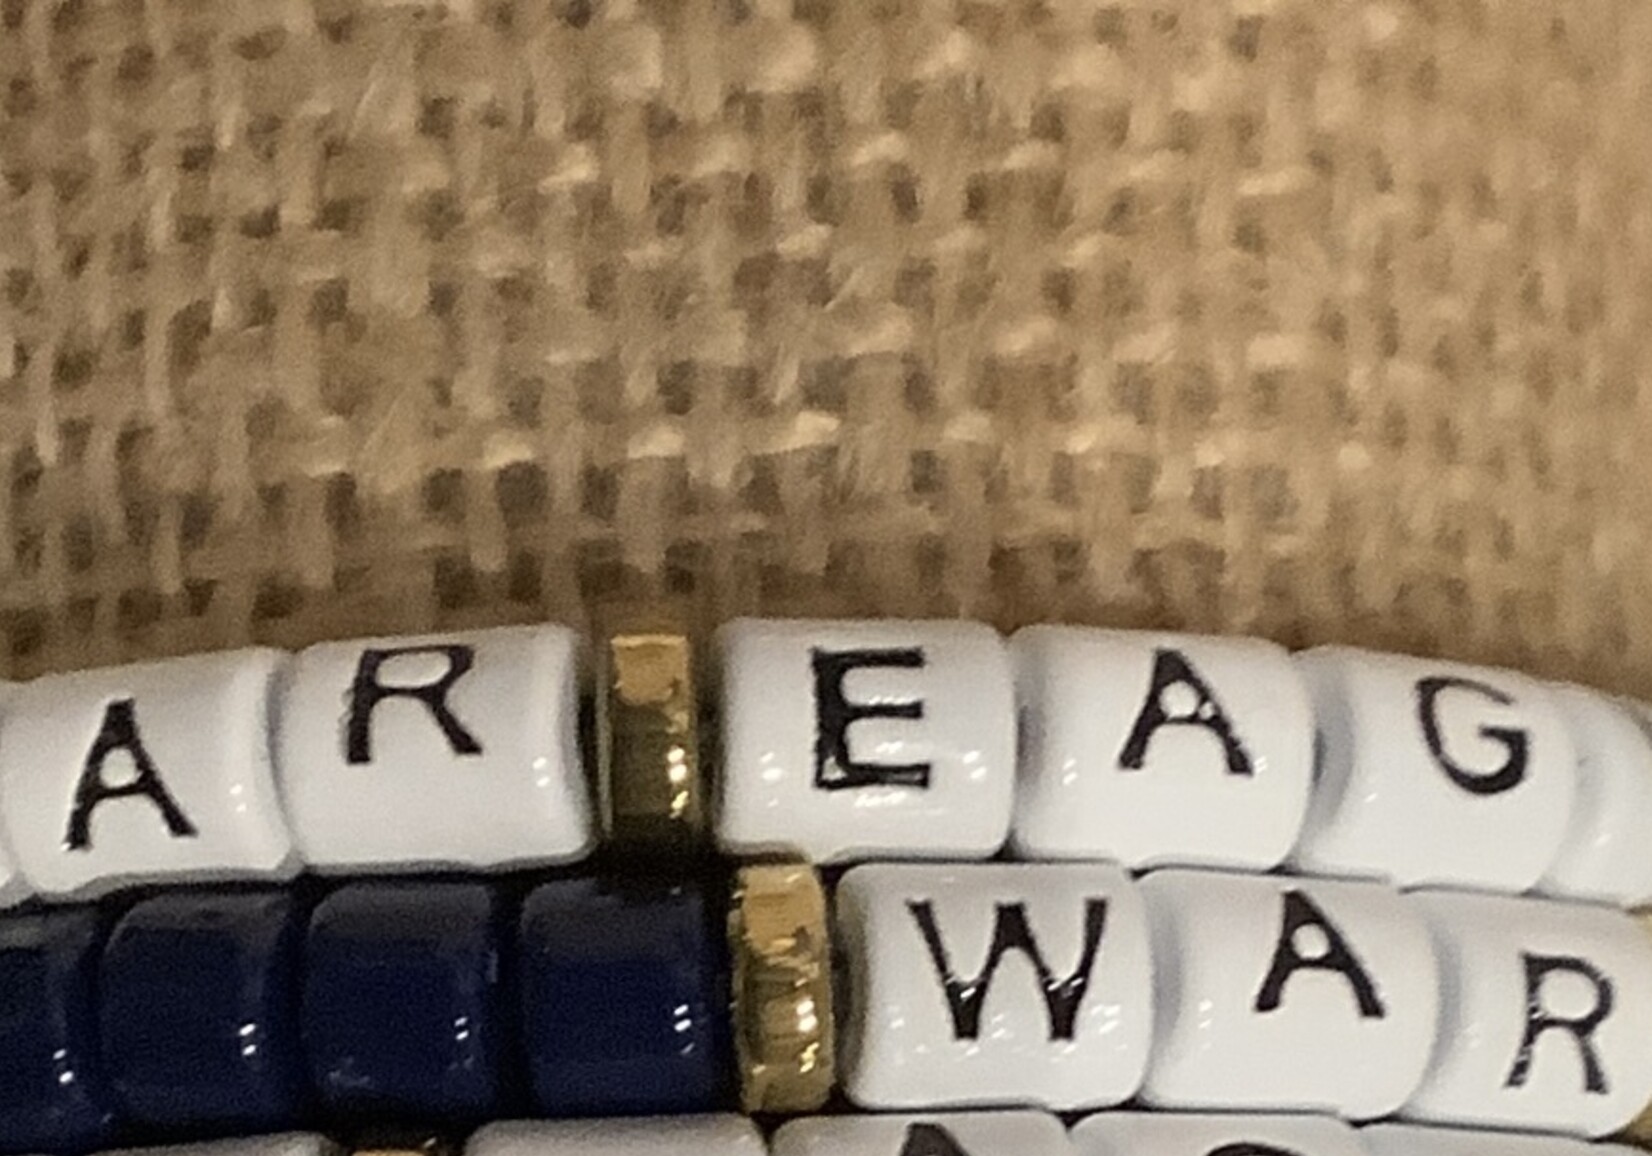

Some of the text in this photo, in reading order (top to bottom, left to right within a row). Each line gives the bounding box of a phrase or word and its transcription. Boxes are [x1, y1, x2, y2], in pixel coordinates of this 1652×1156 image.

[65, 642, 1530, 853] AR EAG
[907, 889, 1614, 1094] WAR
